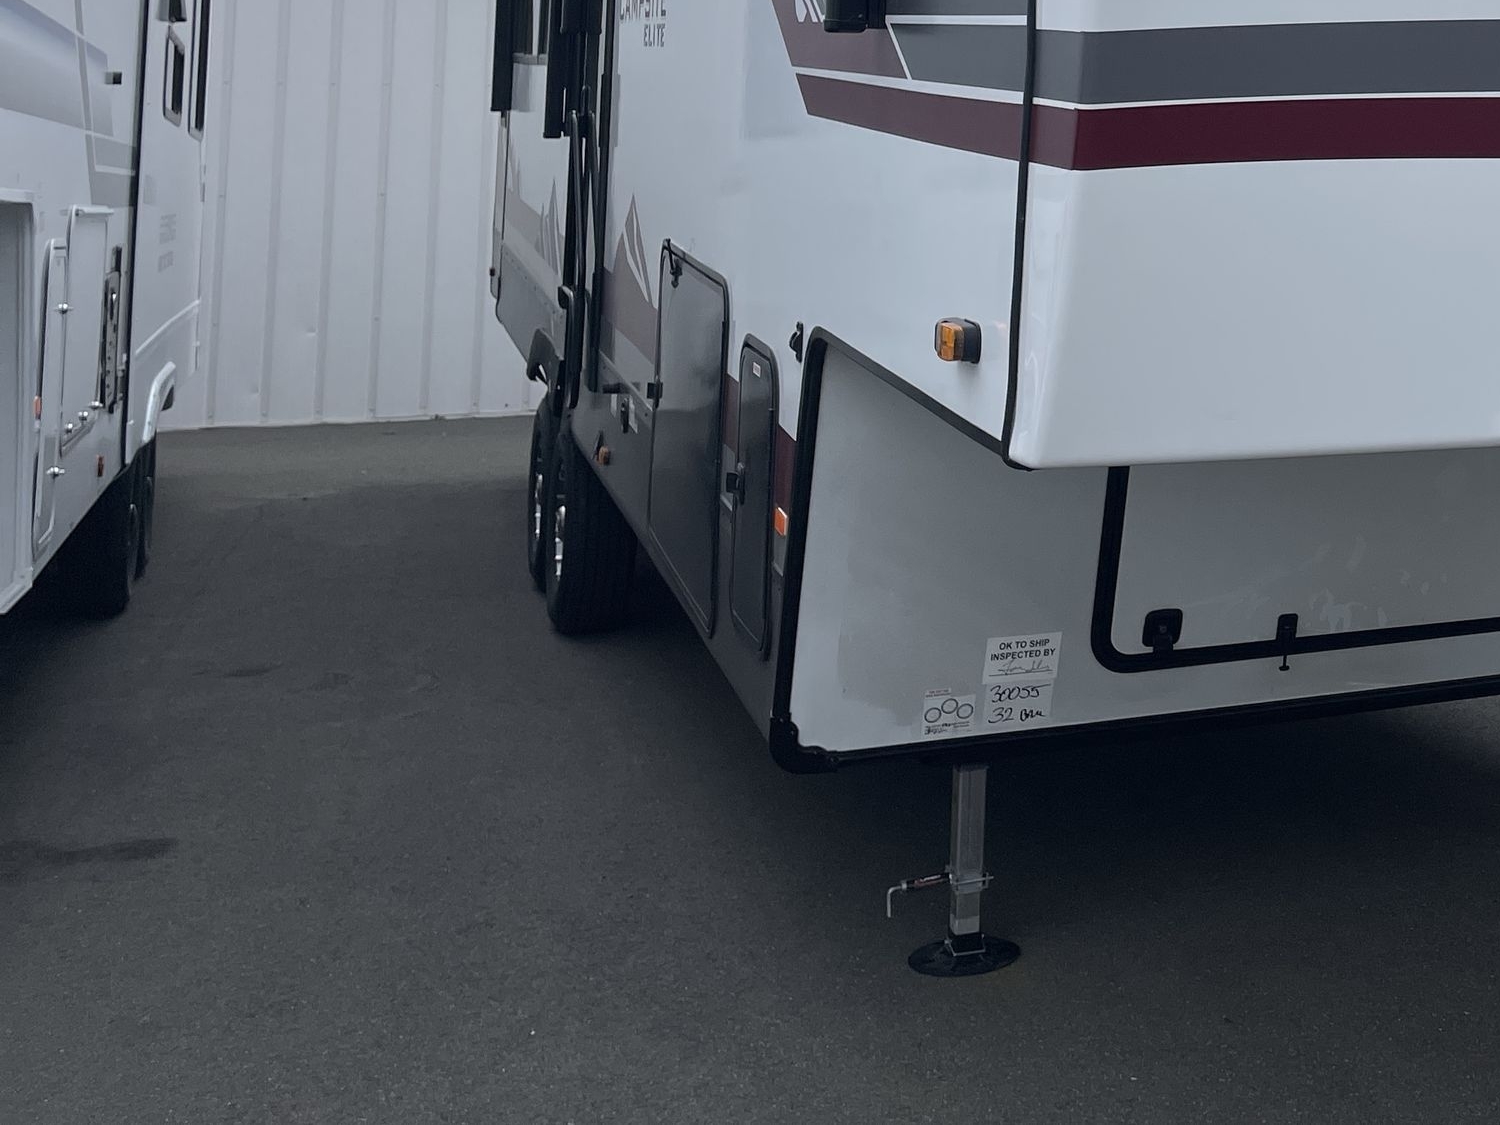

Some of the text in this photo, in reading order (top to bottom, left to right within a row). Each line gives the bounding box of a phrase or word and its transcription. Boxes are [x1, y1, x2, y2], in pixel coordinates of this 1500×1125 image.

[643, 23, 666, 47] ELITE
[999, 638, 1050, 650] OK TO SHIP
[990, 648, 1056, 661] INSPECTED BY
[988, 707, 1014, 723] 32
